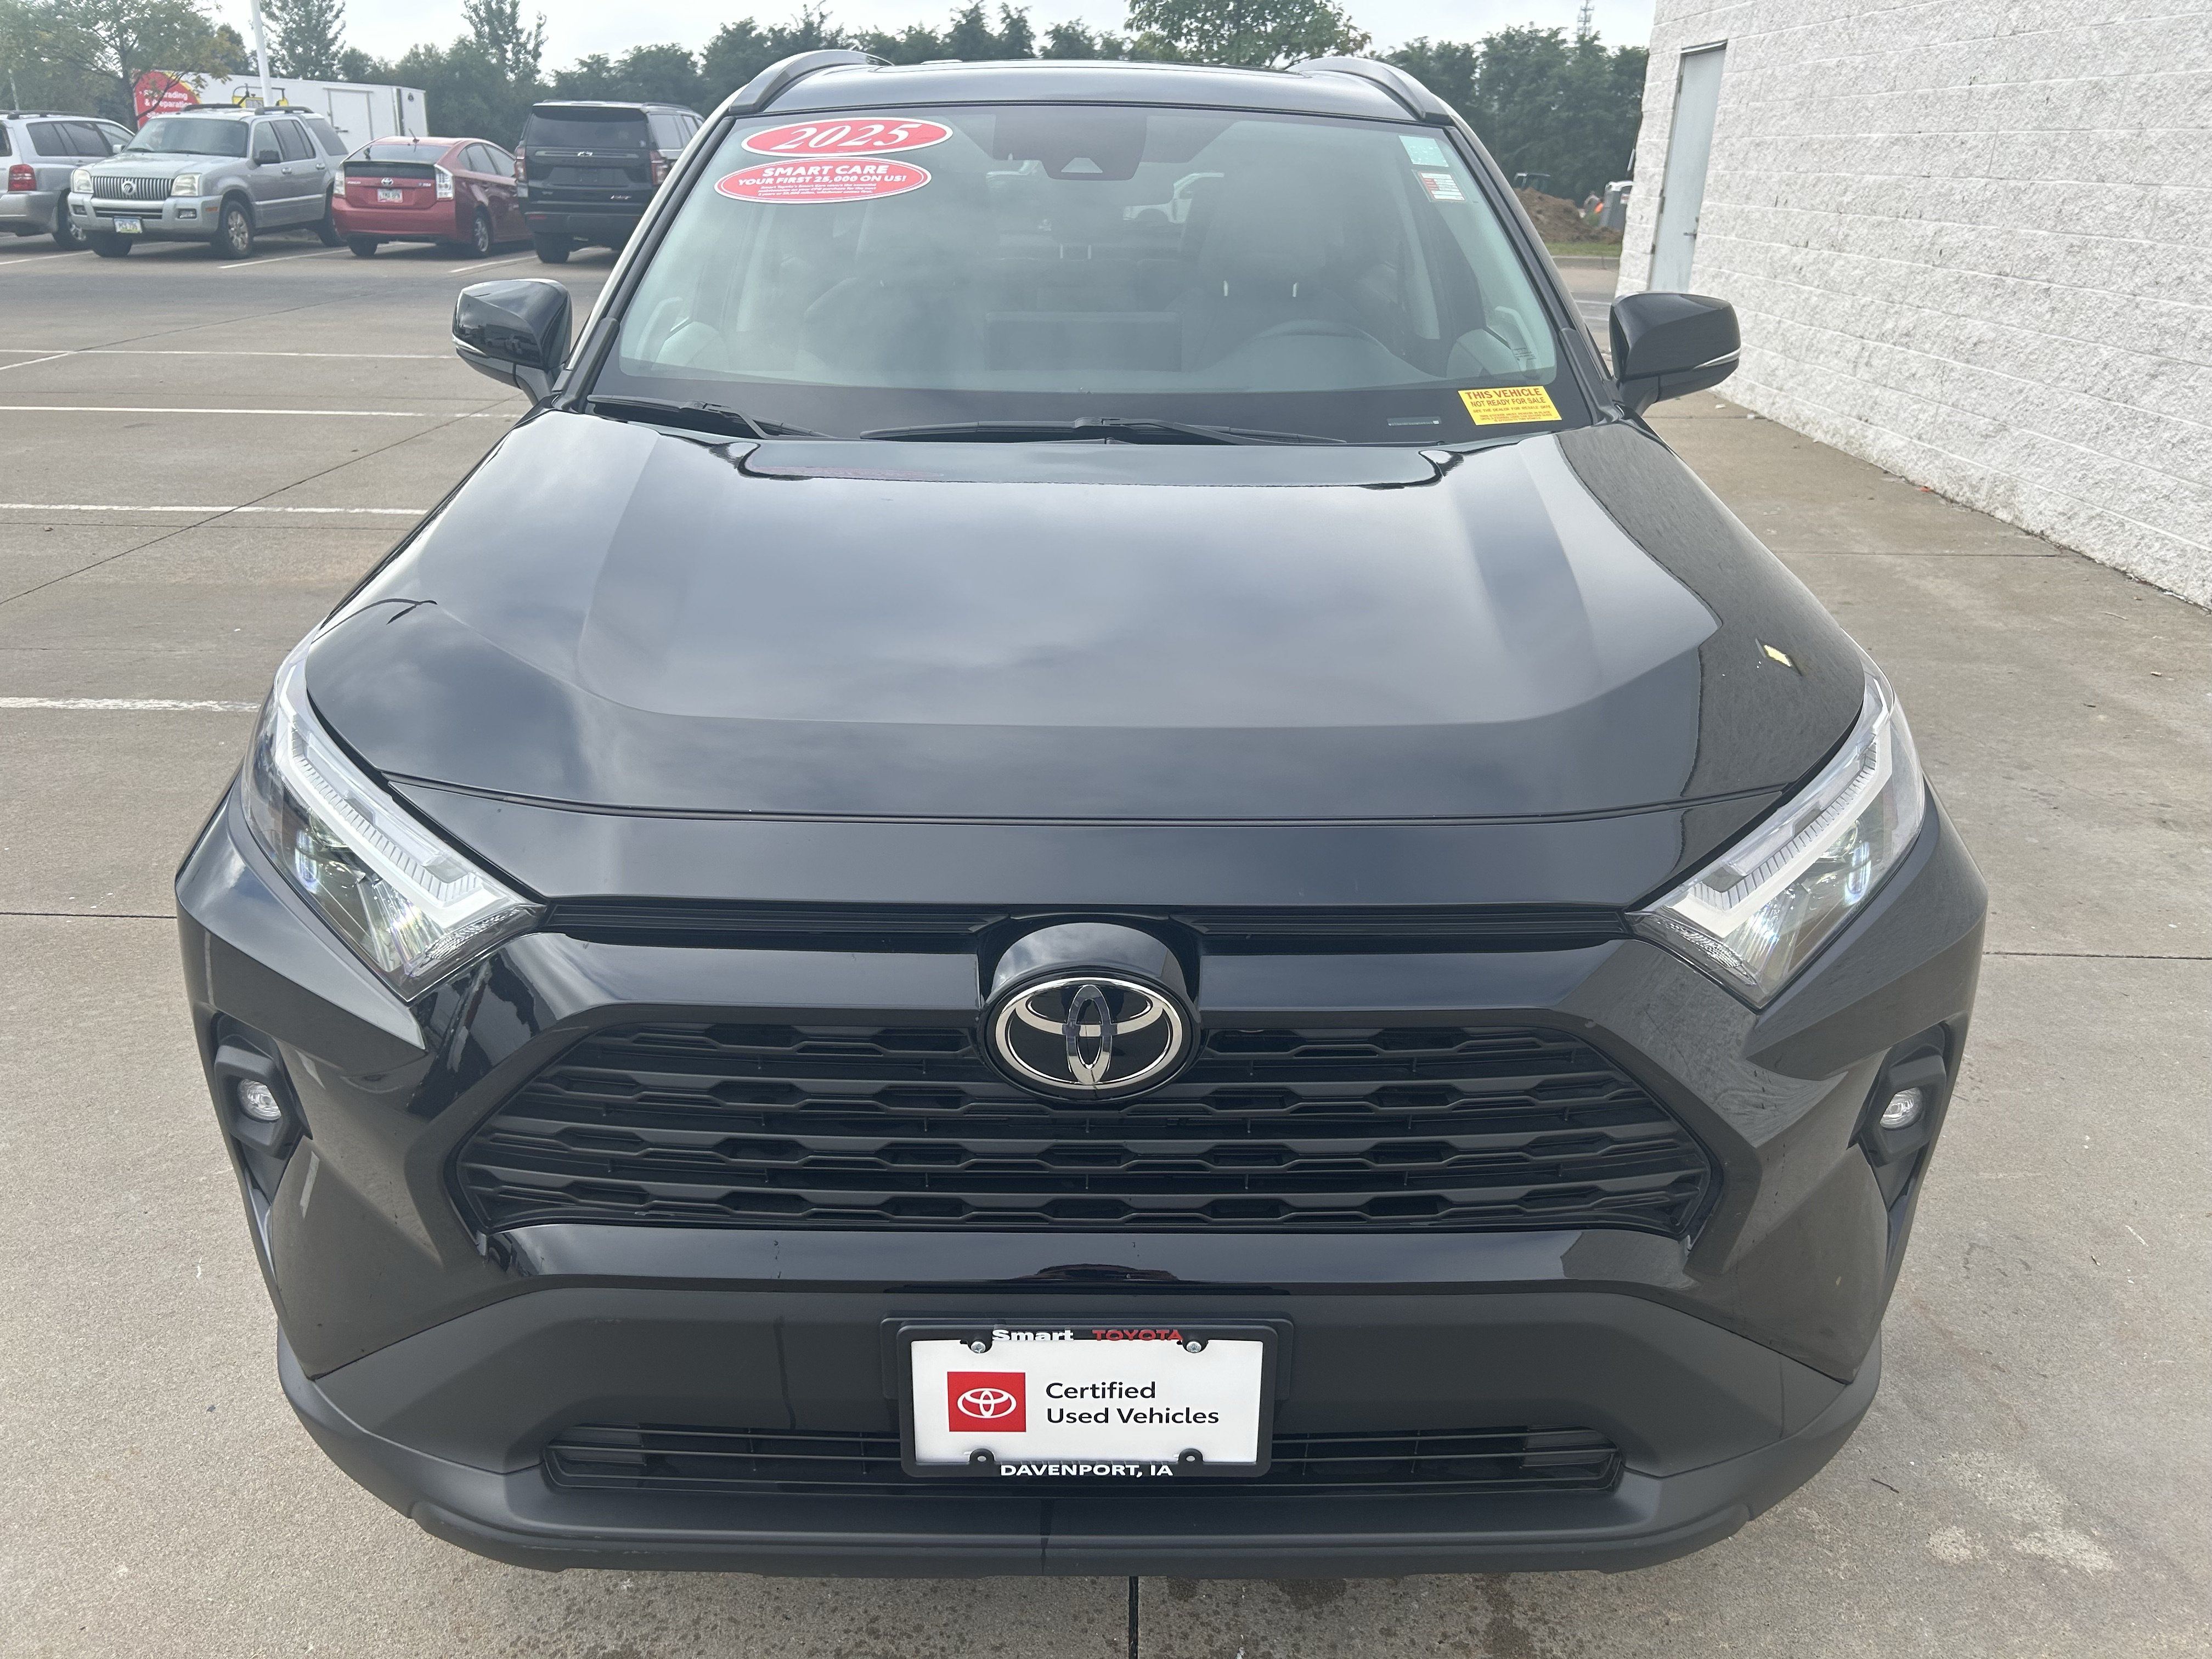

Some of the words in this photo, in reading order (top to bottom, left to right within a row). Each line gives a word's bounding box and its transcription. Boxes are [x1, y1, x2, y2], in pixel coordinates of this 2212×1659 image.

[769, 123, 922, 150] 2025
[763, 165, 833, 177] SMART
[835, 165, 889, 174] CARE
[738, 177, 774, 186] YOUR
[776, 176, 812, 184] FIRST
[1465, 391, 1493, 400] THIS
[1493, 388, 1542, 398] VEHICLE
[992, 1329, 1074, 1341] Smart
[1092, 1329, 1183, 1341] TOYOTA
[1046, 1381, 1155, 1400] Certified
[1047, 1408, 1109, 1424] Used
[1117, 1407, 1219, 1424] Vehicles
[1001, 1464, 1142, 1478] DAVENPORT,
[1150, 1464, 1173, 1476] IA
